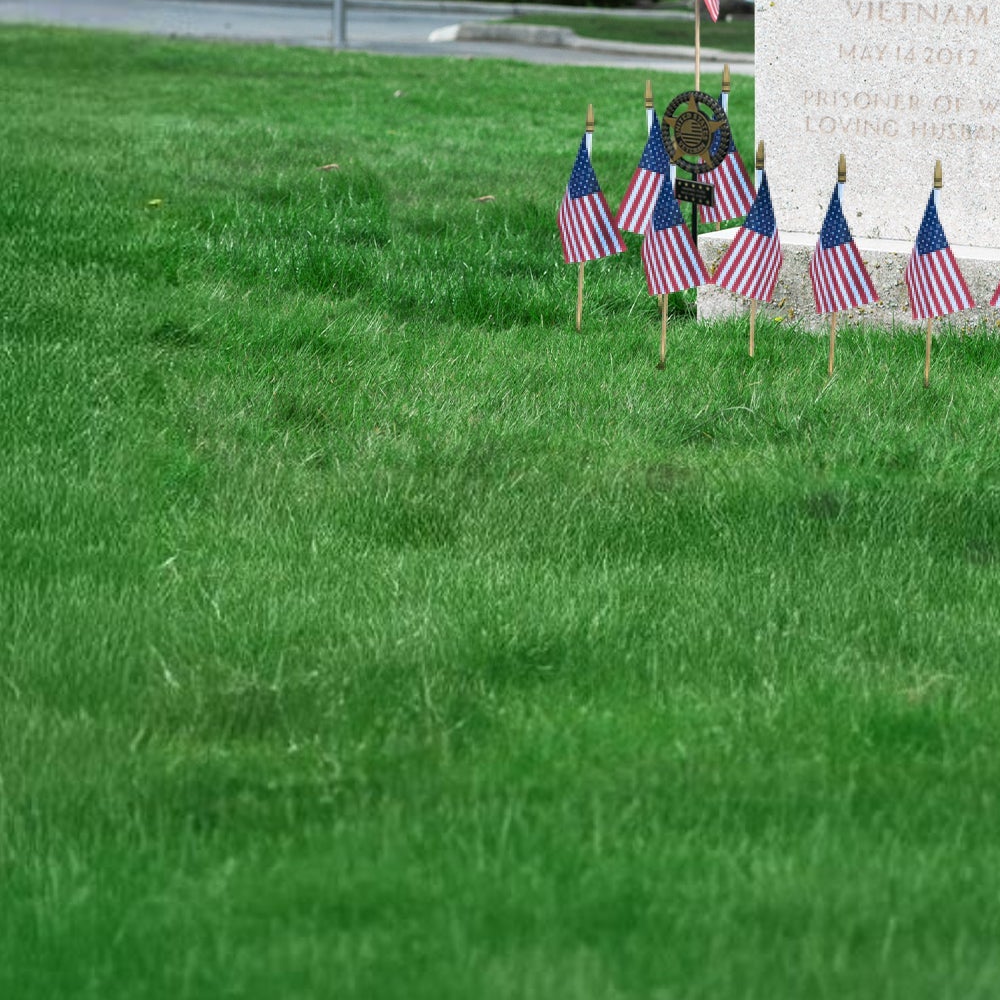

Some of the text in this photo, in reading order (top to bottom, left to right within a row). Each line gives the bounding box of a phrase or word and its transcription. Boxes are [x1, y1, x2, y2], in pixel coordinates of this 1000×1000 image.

[846, 0, 990, 26] VIETNAM
[838, 43, 889, 62] MAY
[923, 46, 979, 66] 2012
[803, 89, 921, 112] PRISONER
[933, 95, 962, 115] OF
[804, 115, 900, 138] LOVING
